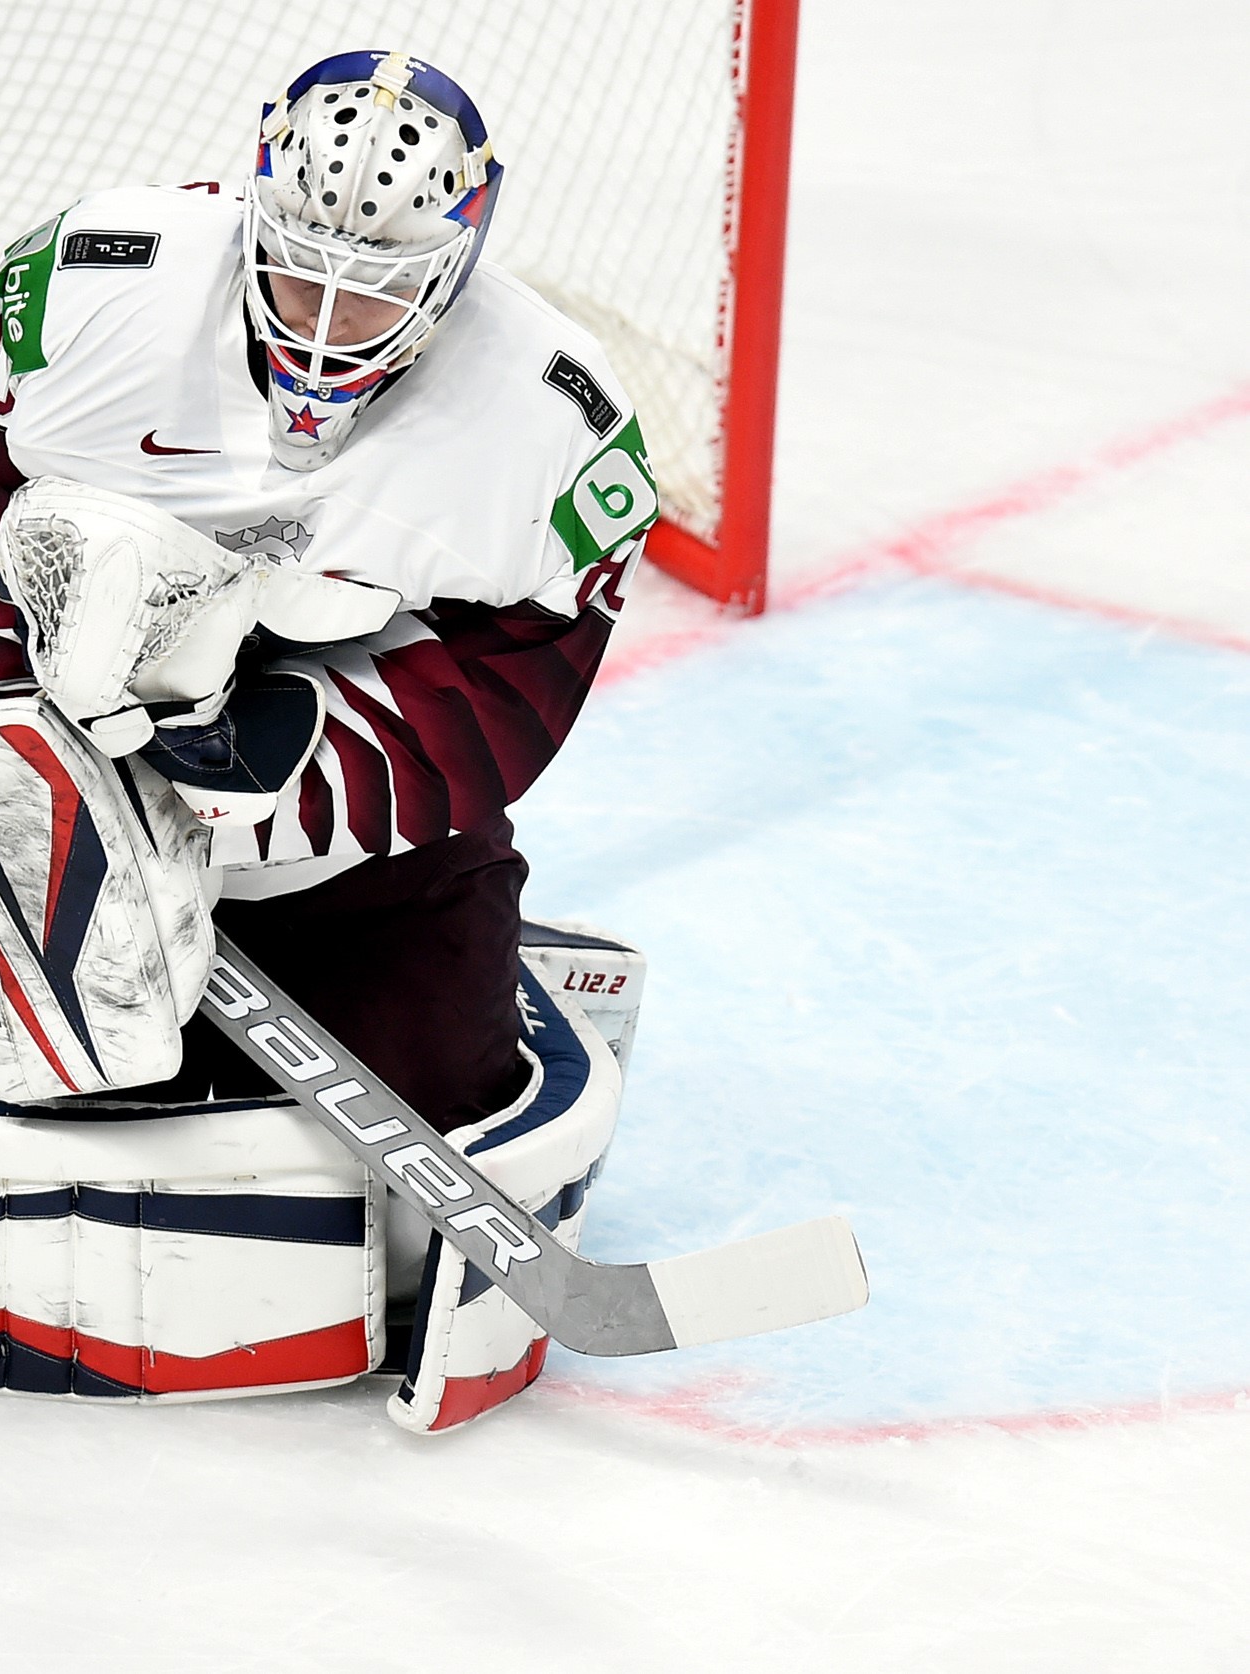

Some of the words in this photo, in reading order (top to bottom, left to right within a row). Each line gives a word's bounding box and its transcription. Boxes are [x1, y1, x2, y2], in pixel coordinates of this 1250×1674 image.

[3, 263, 30, 343] bite
[563, 971, 627, 994] L12.2
[202, 953, 542, 1278] BAUER
